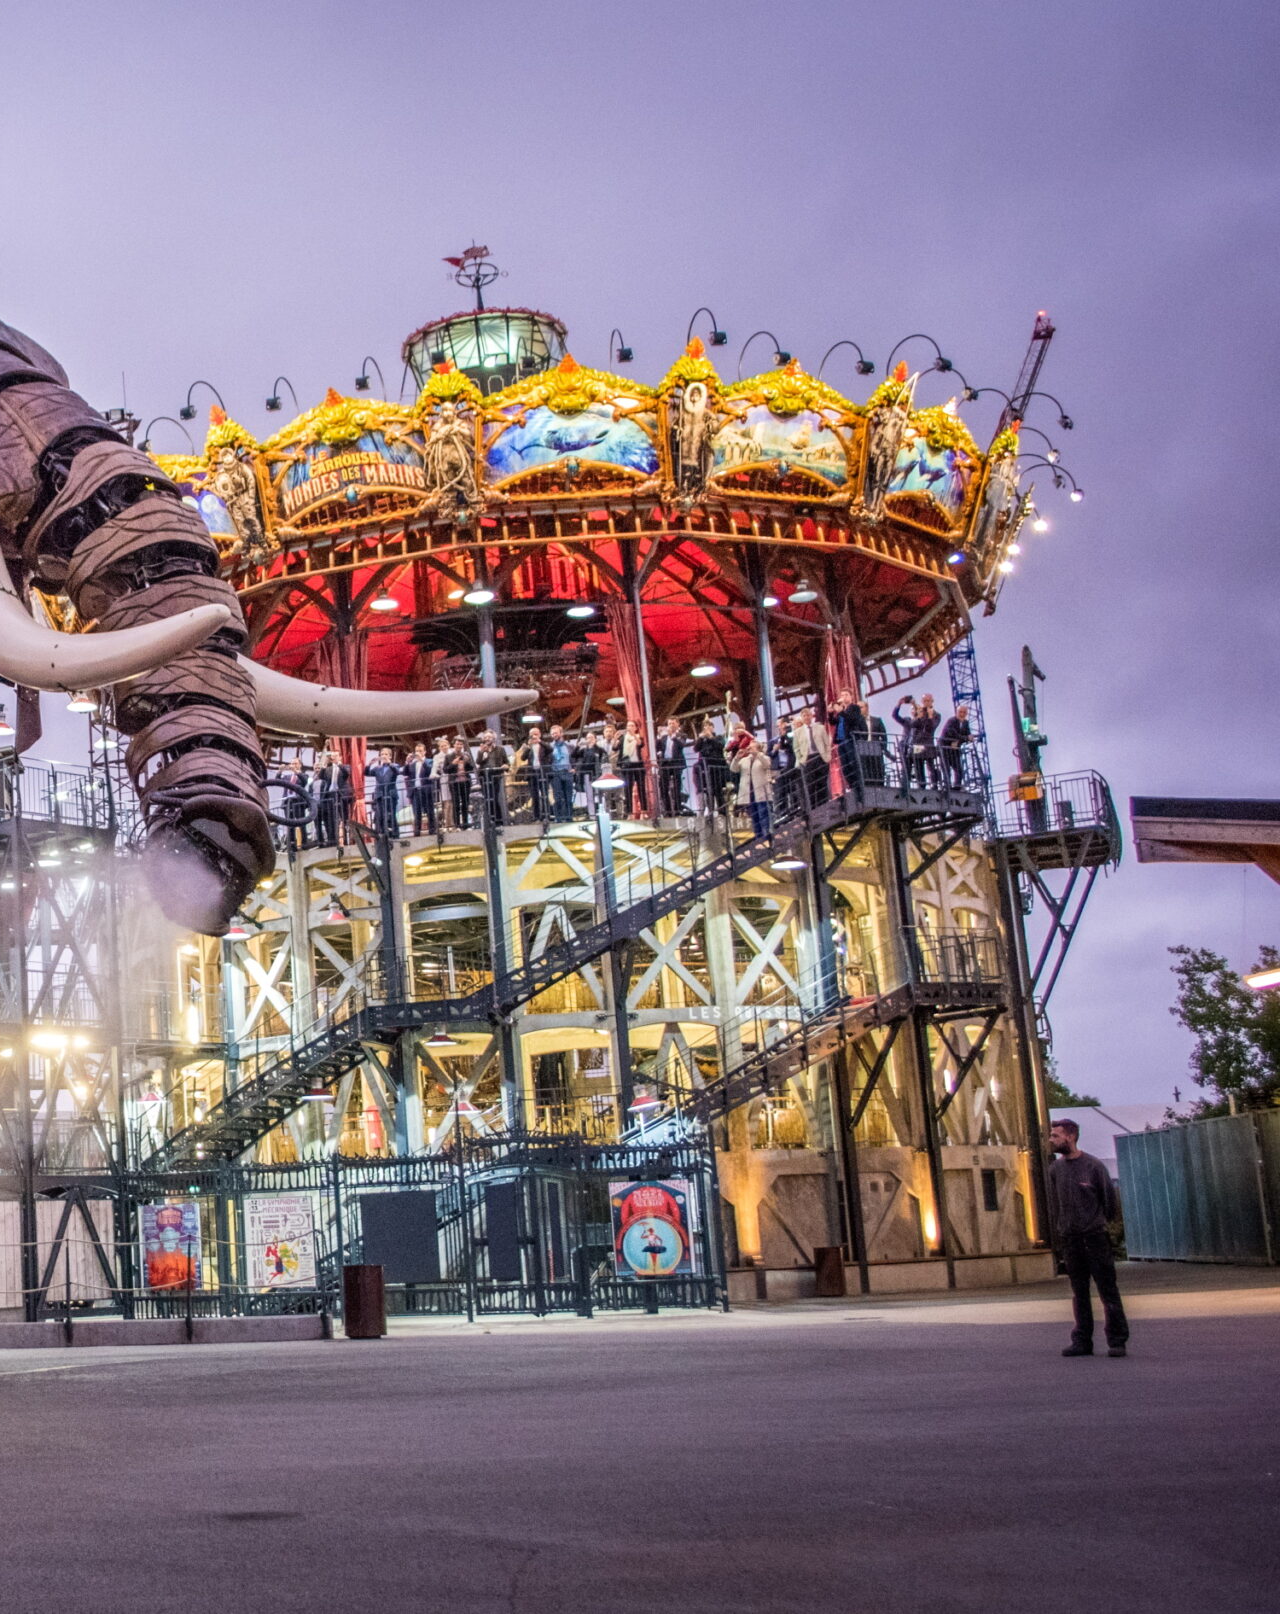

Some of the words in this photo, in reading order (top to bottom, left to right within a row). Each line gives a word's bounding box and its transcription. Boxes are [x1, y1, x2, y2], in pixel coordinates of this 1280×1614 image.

[309, 452, 387, 478] CARROUSEL
[310, 451, 328, 465] LE
[283, 471, 340, 516] MONDES
[342, 465, 361, 481] DES
[364, 464, 425, 488] MARINS
[689, 1006, 721, 1019] LES
